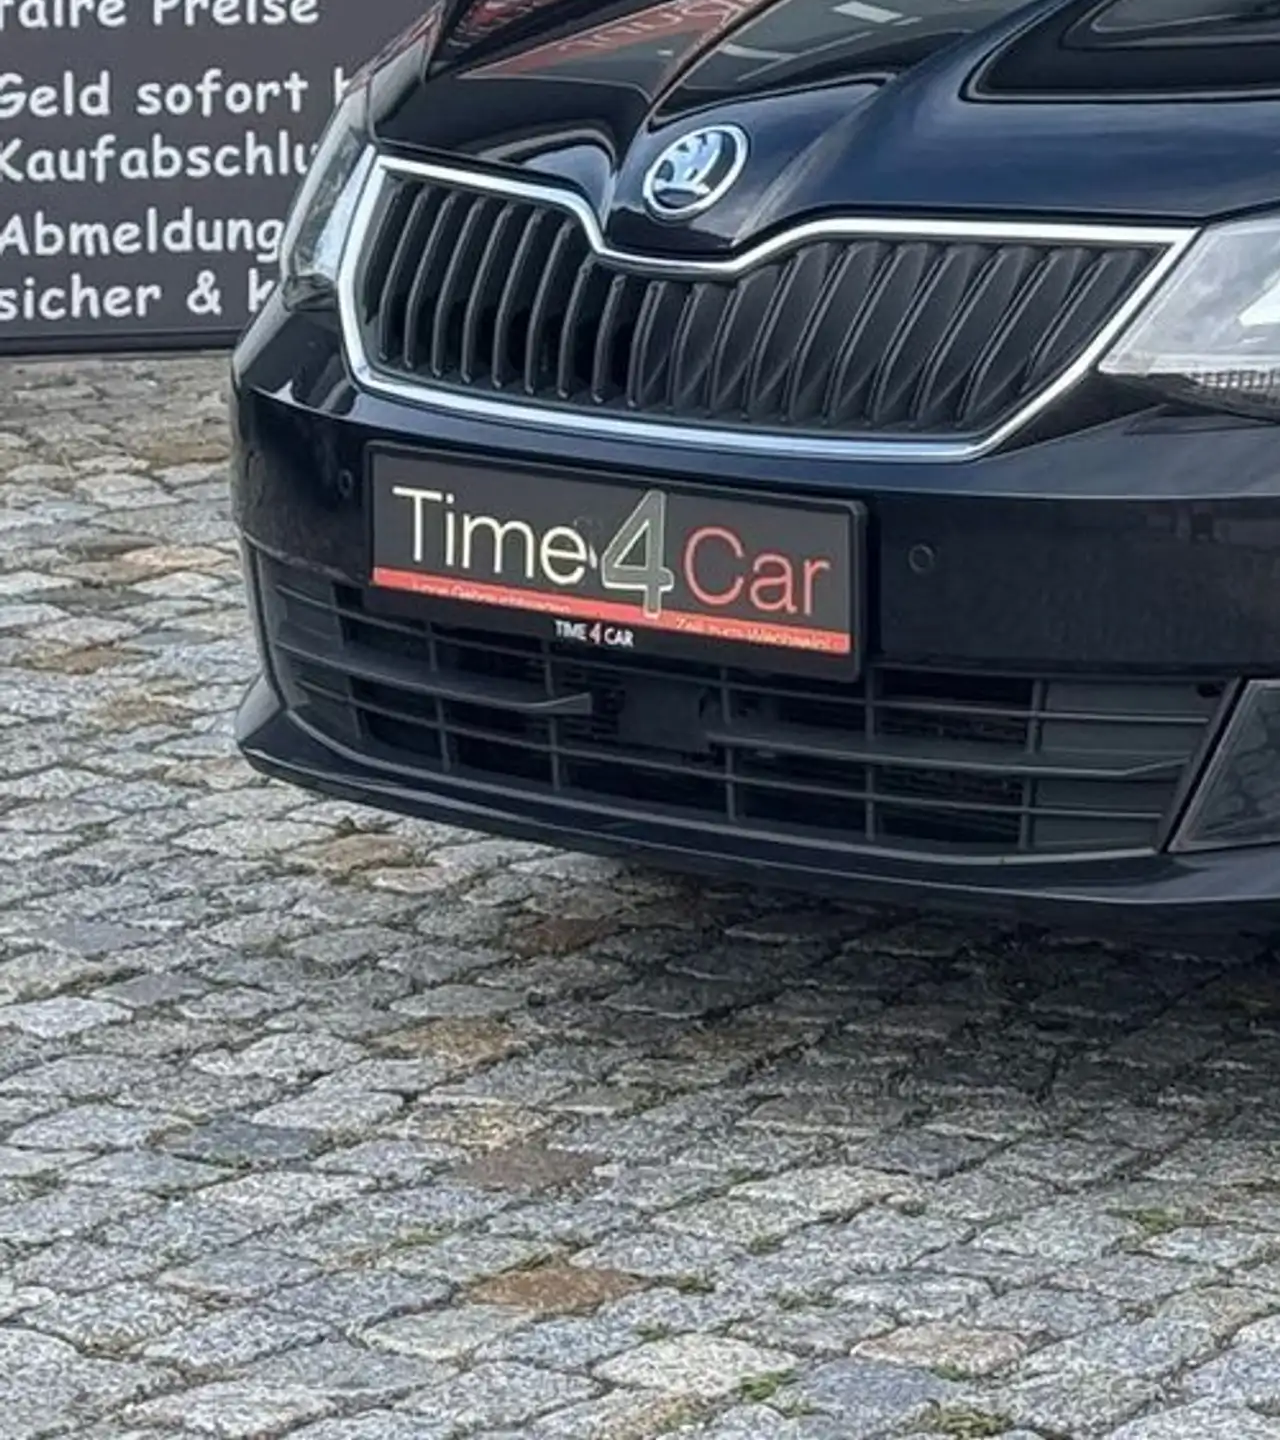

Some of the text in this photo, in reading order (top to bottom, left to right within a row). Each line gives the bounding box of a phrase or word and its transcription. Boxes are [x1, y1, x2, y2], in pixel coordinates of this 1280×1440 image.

[0, 70, 110, 118] Geld
[136, 68, 309, 117] sofort
[0, 272, 161, 321] sicher
[186, 269, 223, 316] &
[554, 620, 588, 642] TIME
[603, 627, 635, 649] CAR
